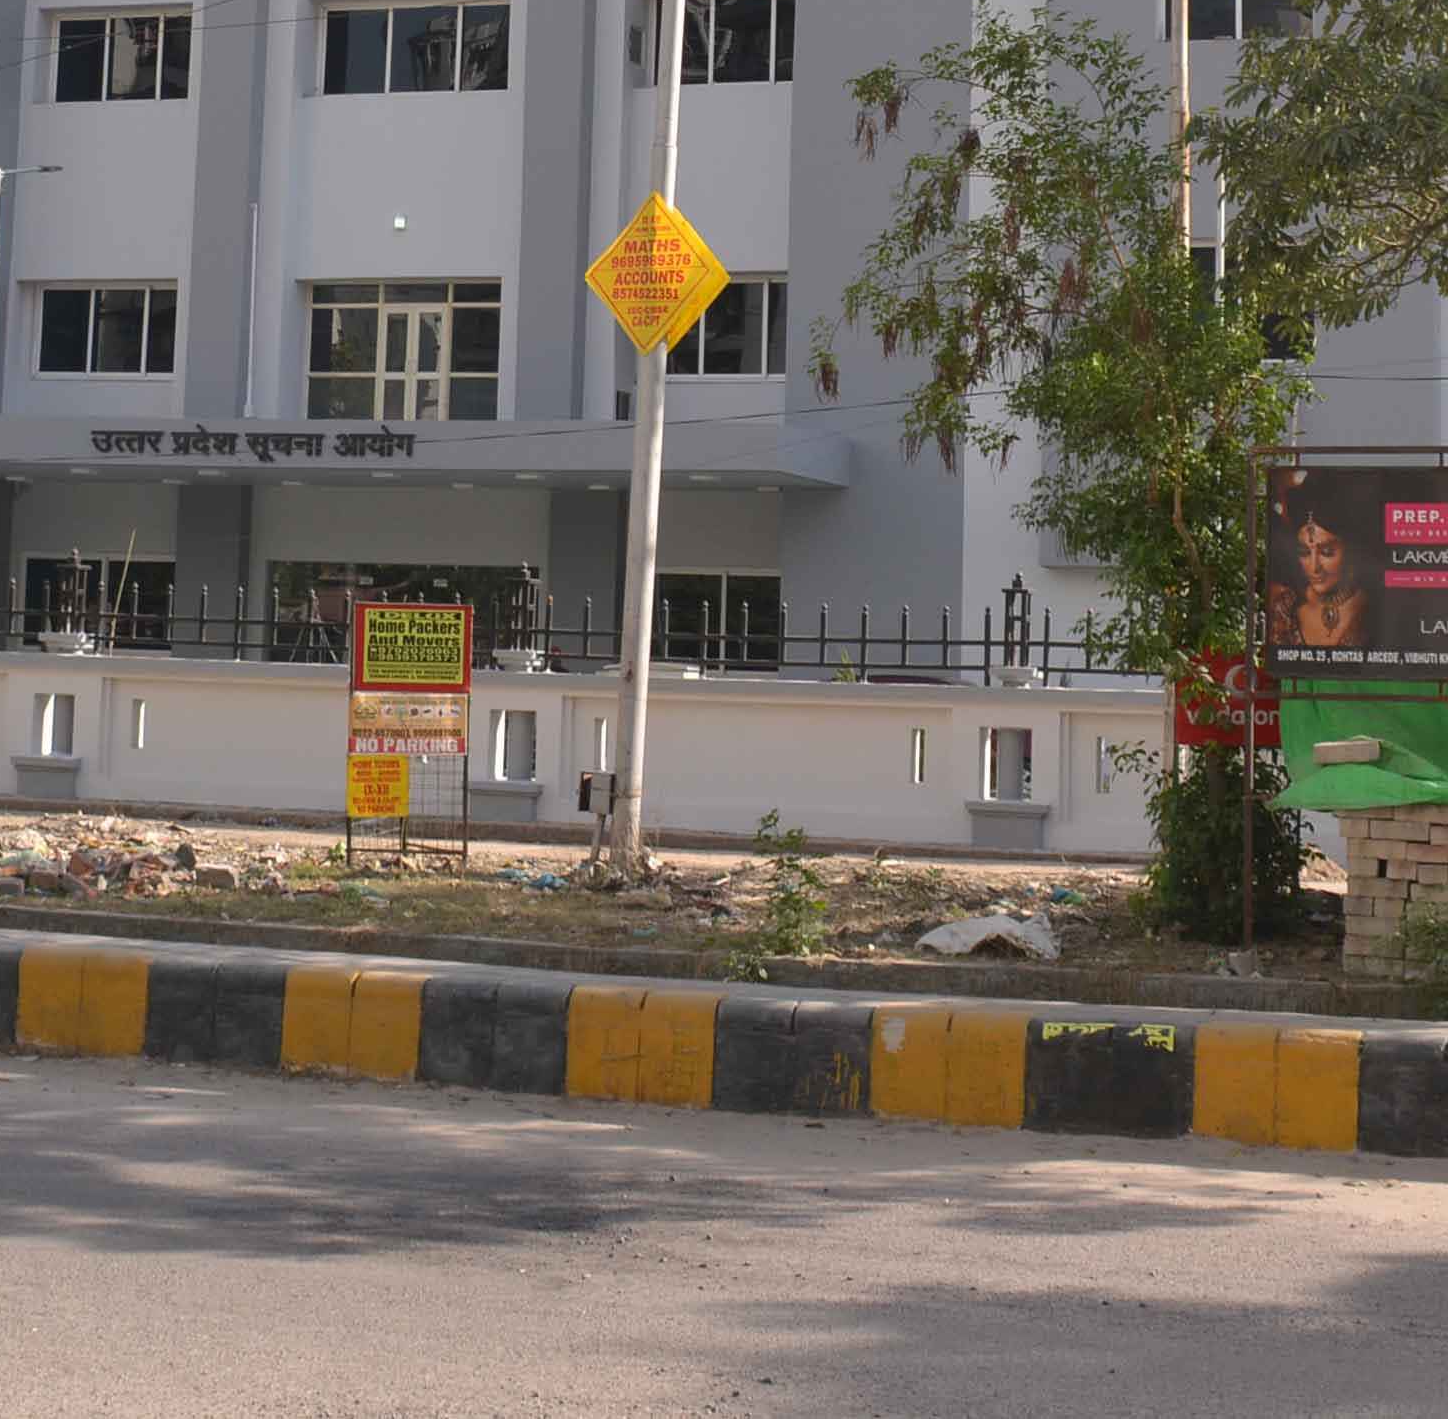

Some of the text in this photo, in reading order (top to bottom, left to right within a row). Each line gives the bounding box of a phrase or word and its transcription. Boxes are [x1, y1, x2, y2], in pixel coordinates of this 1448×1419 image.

[624, 239, 680, 253] MATHS
[614, 270, 684, 285] ACCOUNTS
[91, 424, 416, 463] उत्तर प्रदेश सूचना आयोग
[1393, 509, 1445, 524] PREP.
[369, 619, 460, 635] Home Packers
[369, 635, 460, 646] And Movers
[1277, 649, 1299, 661] SHOP
[1332, 650, 1364, 663] ROHTAS
[1404, 652, 1437, 665] VIBHUTI
[356, 737, 458, 753] NO PARKING
